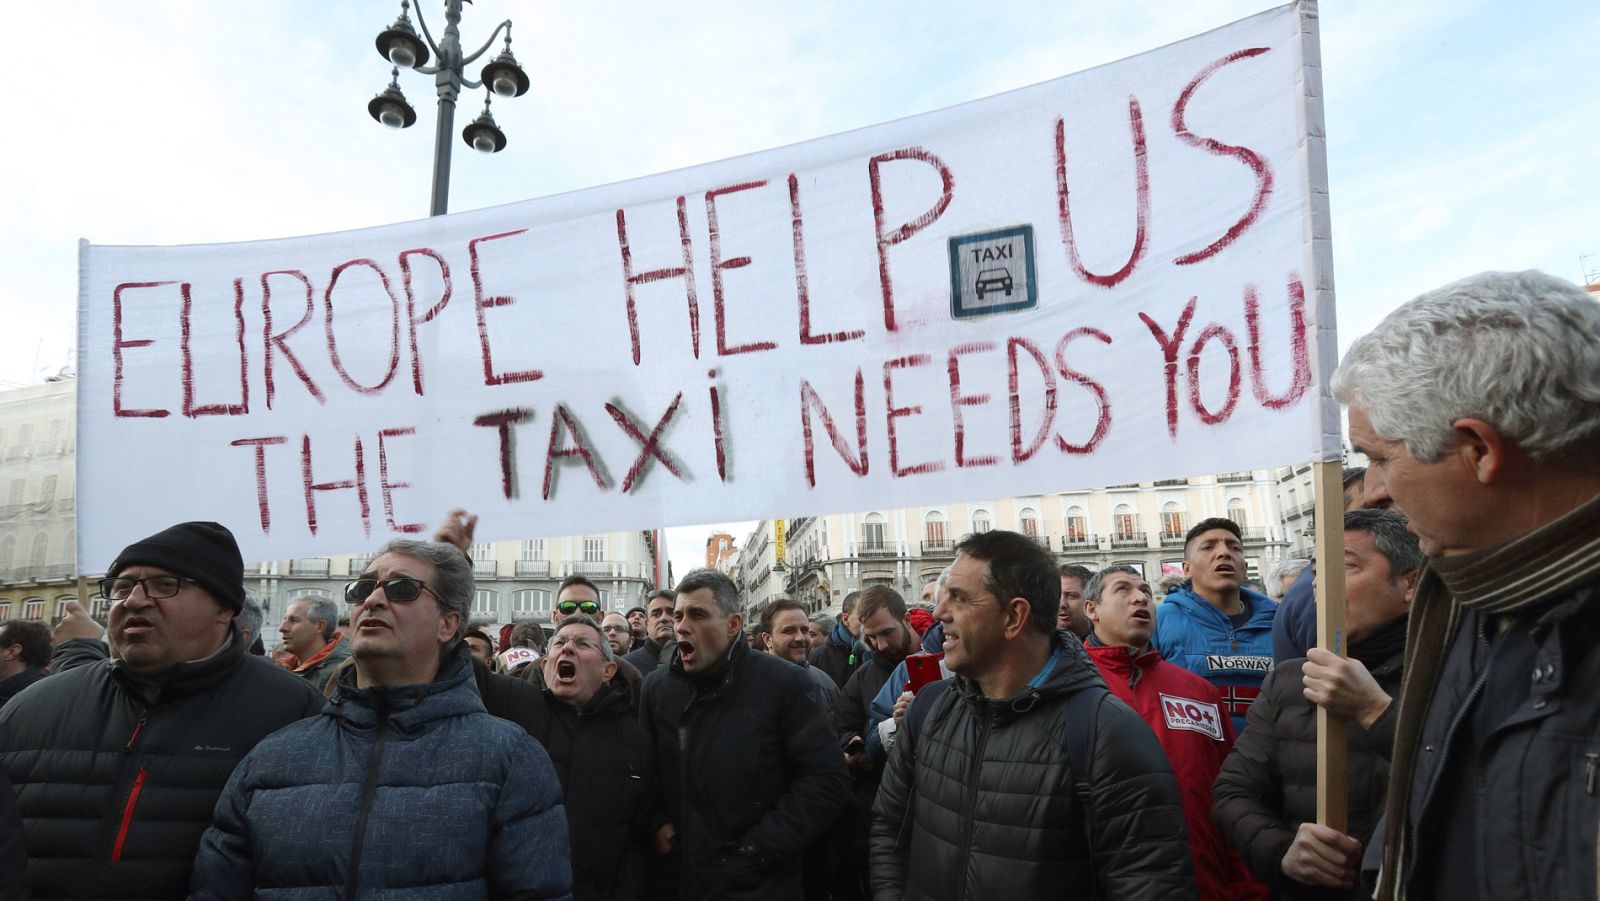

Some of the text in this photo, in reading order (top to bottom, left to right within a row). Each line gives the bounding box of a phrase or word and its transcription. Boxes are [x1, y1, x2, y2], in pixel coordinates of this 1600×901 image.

[113, 46, 1274, 417] EUROPE HELP US
[970, 243, 1013, 263] TAXI
[230, 428, 427, 536] THE
[799, 326, 1113, 488] NEEDS
[1138, 270, 1312, 441] YOU
[1208, 656, 1271, 671] NORWAY
[1165, 701, 1214, 724] NO+
